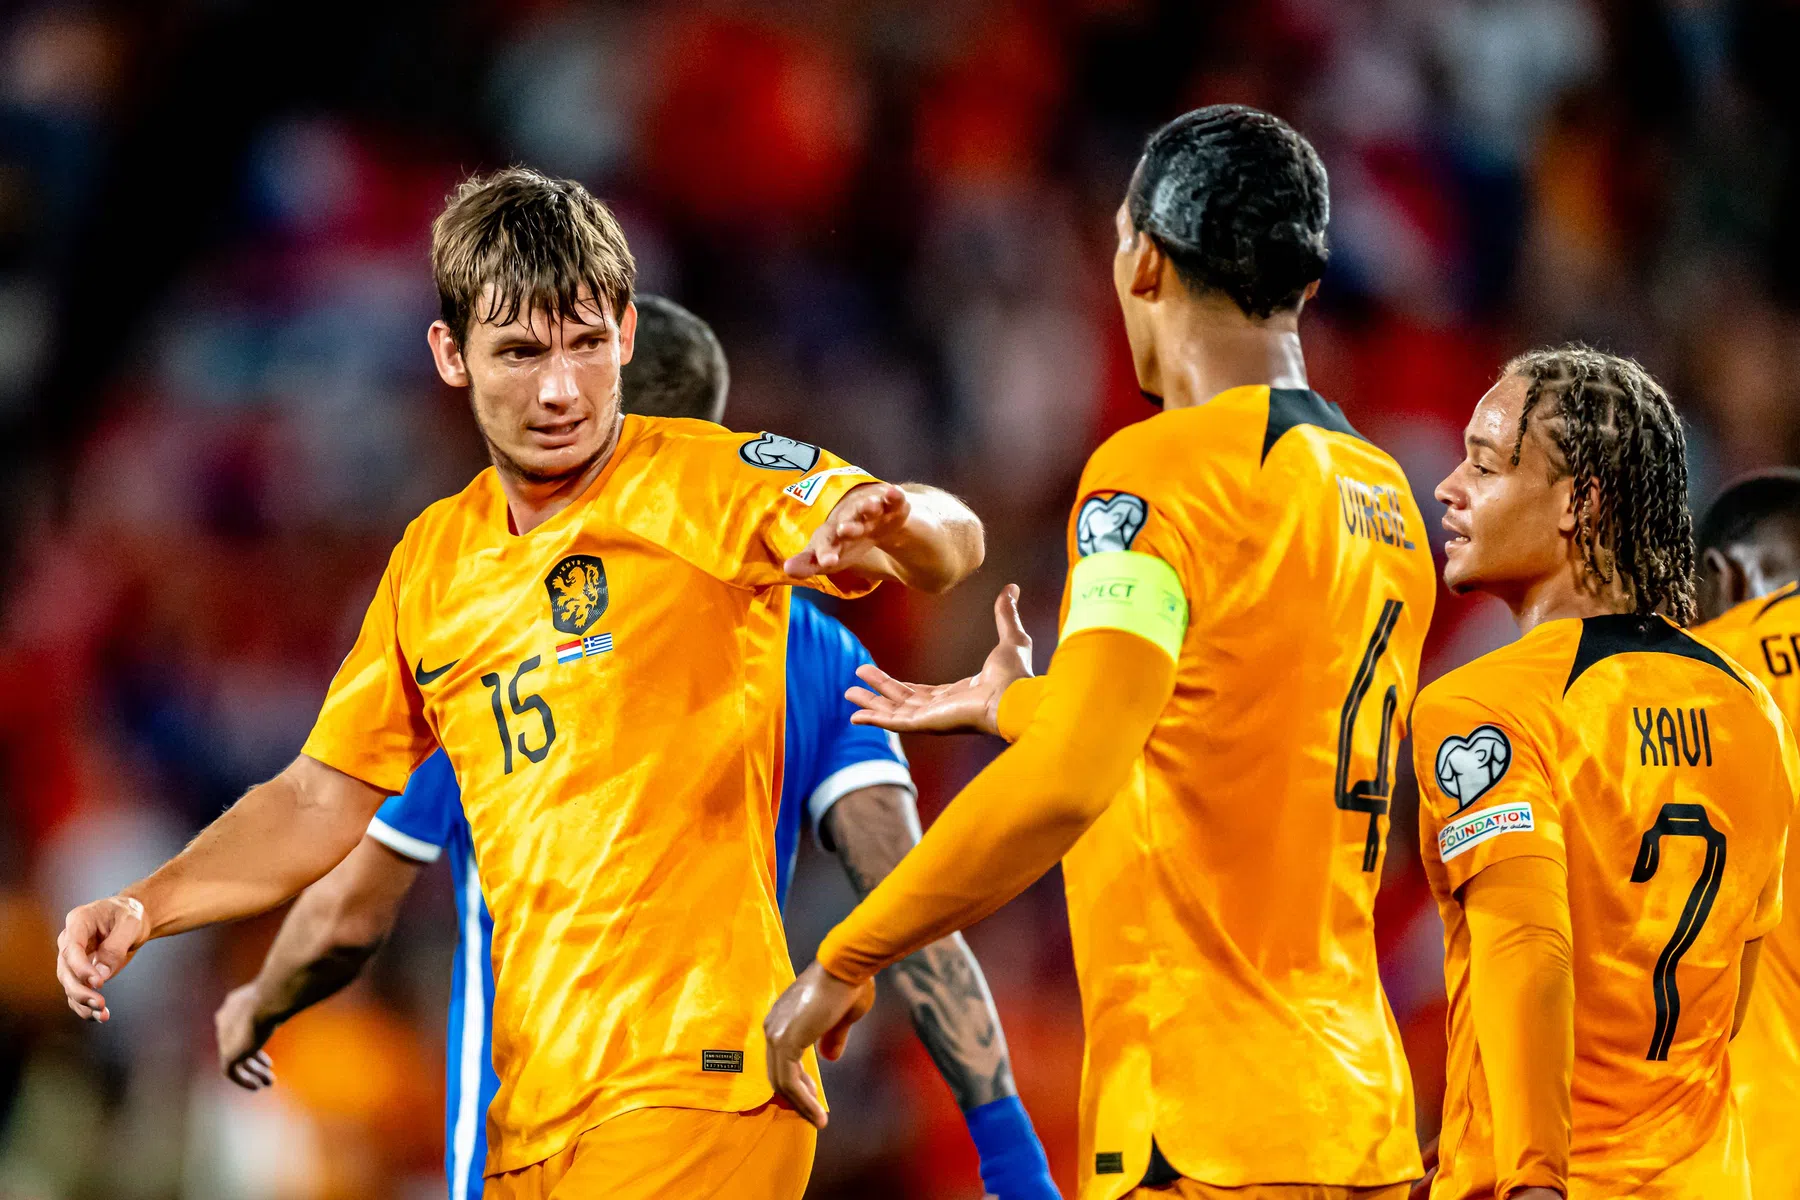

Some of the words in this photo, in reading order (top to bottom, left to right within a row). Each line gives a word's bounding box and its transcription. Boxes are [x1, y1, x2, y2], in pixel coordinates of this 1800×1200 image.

[1335, 474, 1415, 550] VIRGIL
[480, 654, 556, 775] 15
[1335, 598, 1404, 873] 4
[1633, 707, 1712, 767] XAVI
[1440, 811, 1531, 852] FOUNDATION
[1630, 803, 1726, 1061] 7
